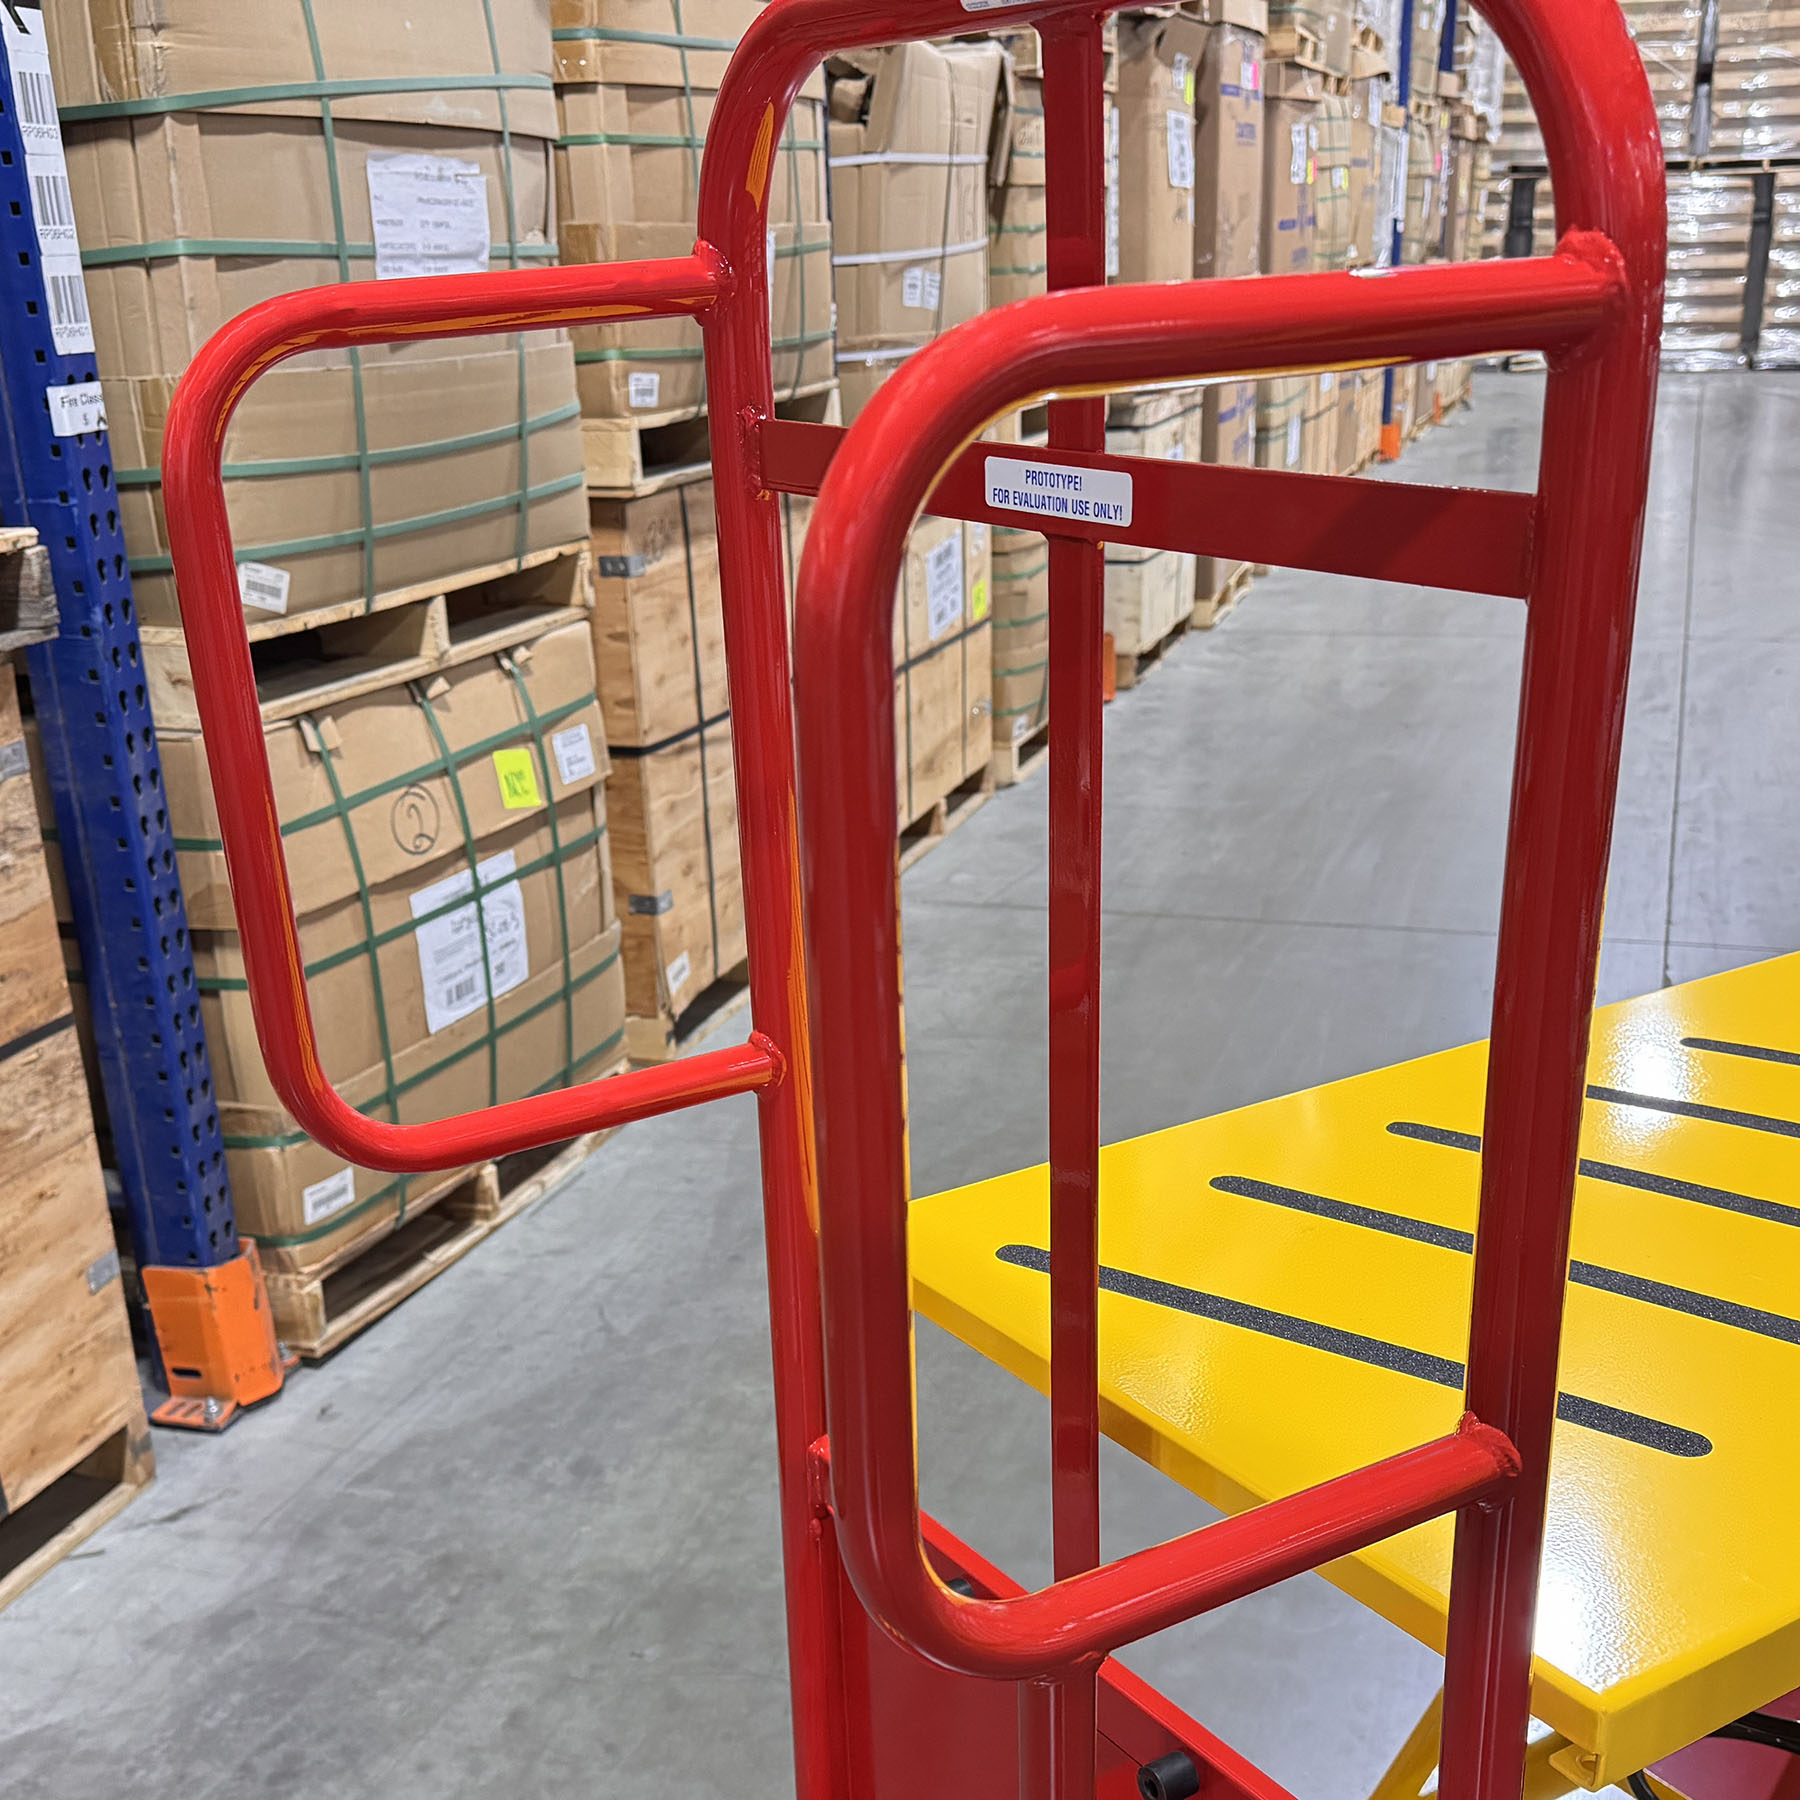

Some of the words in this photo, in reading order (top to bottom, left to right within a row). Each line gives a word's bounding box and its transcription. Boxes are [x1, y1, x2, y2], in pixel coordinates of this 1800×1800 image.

[1025, 469, 1082, 491] PROTOTYPE!
[992, 487, 1010, 504] FOR
[1013, 490, 1068, 513] EVALUATION
[1071, 499, 1090, 516] USE
[1093, 502, 1123, 521] ONLY!
